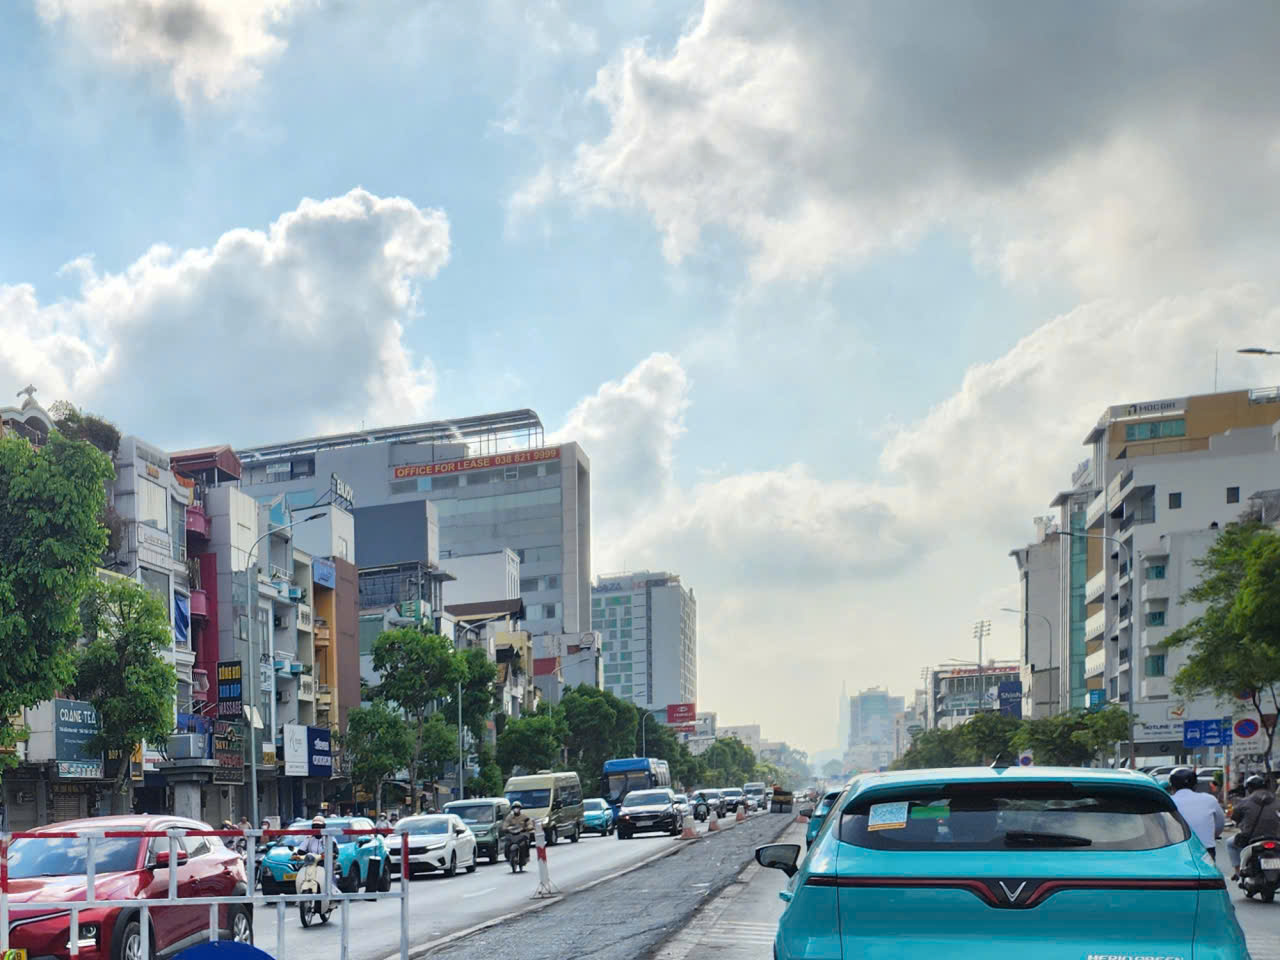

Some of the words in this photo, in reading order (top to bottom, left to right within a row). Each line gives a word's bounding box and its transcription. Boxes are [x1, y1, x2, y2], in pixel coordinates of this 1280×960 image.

[396, 465, 433, 478] OFFICE
[435, 463, 456, 473] FOR
[457, 459, 490, 470] LEASE
[495, 456, 512, 465] 038
[514, 453, 531, 463] 821
[534, 449, 557, 460] 9999
[219, 700, 242, 715] MASSAGE
